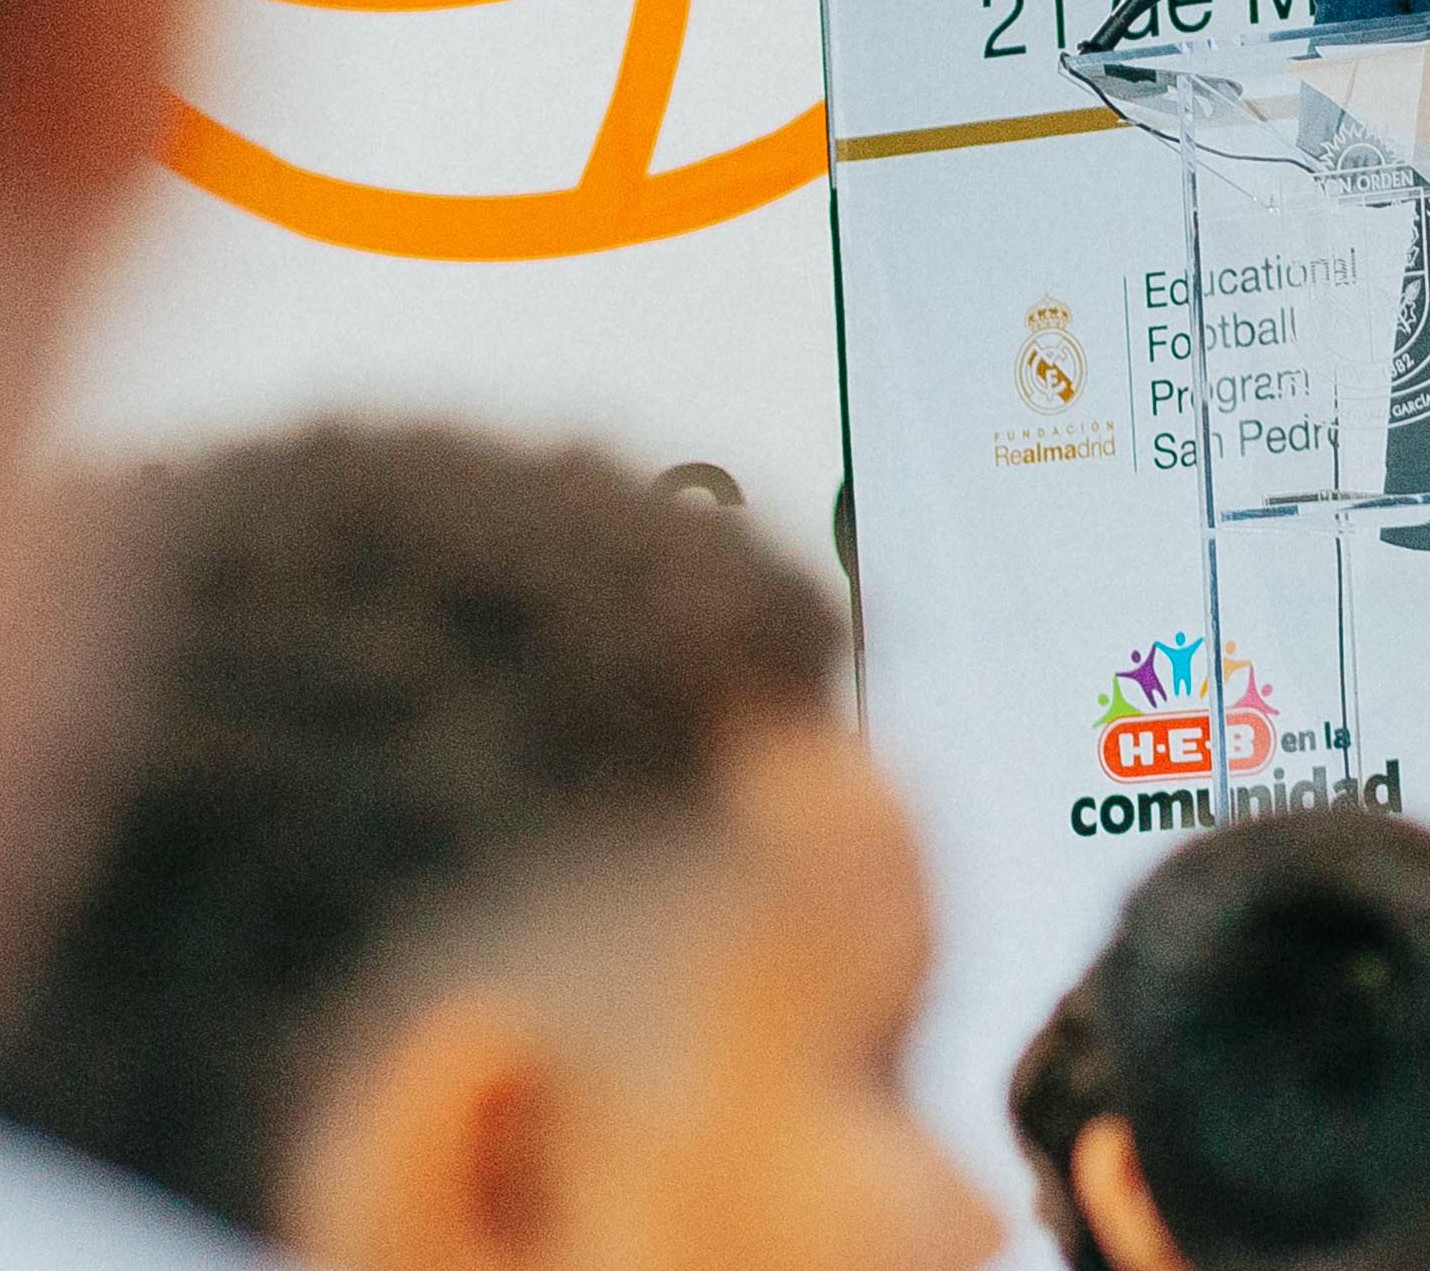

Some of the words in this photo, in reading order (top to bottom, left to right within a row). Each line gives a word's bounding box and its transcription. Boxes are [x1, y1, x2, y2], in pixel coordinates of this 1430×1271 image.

[1357, 170, 1414, 193] ORDEN
[1154, 430, 1224, 470] San
[1281, 728, 1317, 753] en
[1324, 720, 1352, 750] la
